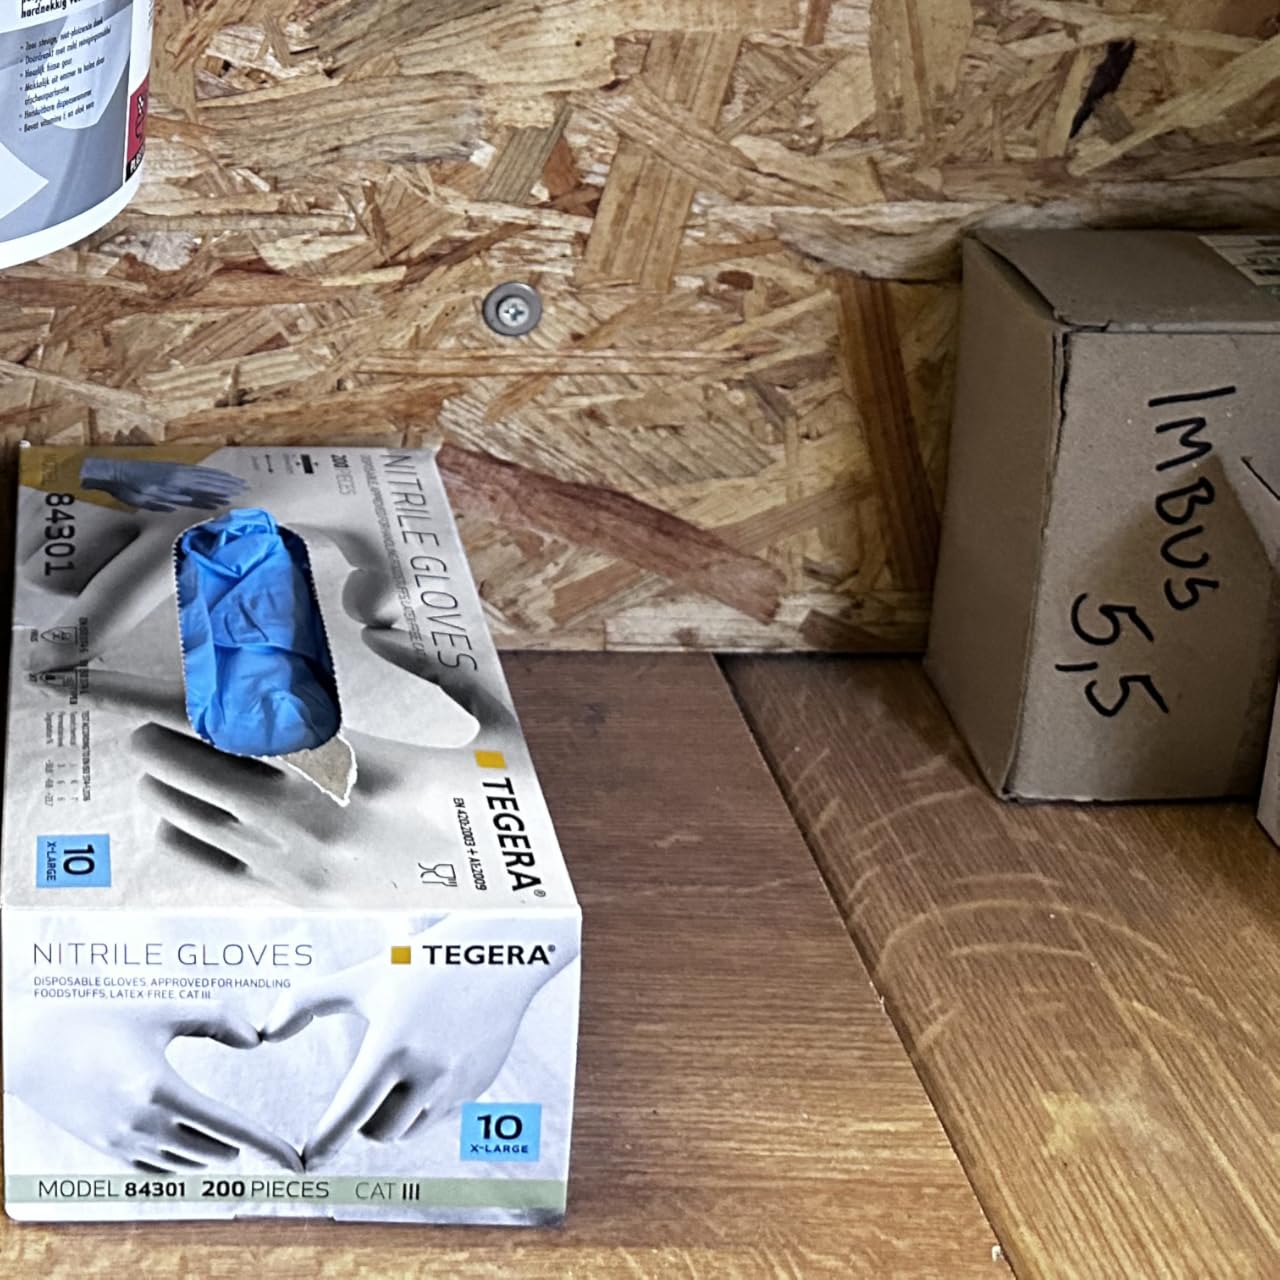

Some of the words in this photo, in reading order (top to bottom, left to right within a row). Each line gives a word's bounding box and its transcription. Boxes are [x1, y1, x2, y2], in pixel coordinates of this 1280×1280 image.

[44, 491, 75, 577] 84301
[380, 454, 440, 548] NITRILE
[410, 555, 478, 672] GLOVES
[453, 797, 465, 808] EN
[45, 840, 58, 882] X-LARGE
[63, 843, 95, 876] 10
[33, 942, 163, 967] NITRILE
[178, 942, 314, 967] GLOVES
[34, 976, 101, 987] DISPOSABLE
[150, 977, 209, 988] APPROVED
[211, 978, 233, 988] FOR
[235, 978, 291, 989] HANDLING
[110, 988, 144, 999] LATEX
[179, 989, 199, 999] CAT
[201, 989, 211, 999] III
[478, 1114, 521, 1141] 10
[470, 1143, 529, 1154] X-LARGE
[38, 1179, 119, 1199] MODEL
[124, 1181, 186, 1198] 84301
[201, 1180, 246, 1199] 200
[250, 1180, 330, 1200] PIECES
[355, 1182, 397, 1200] CAT
[401, 1183, 420, 1200] III
